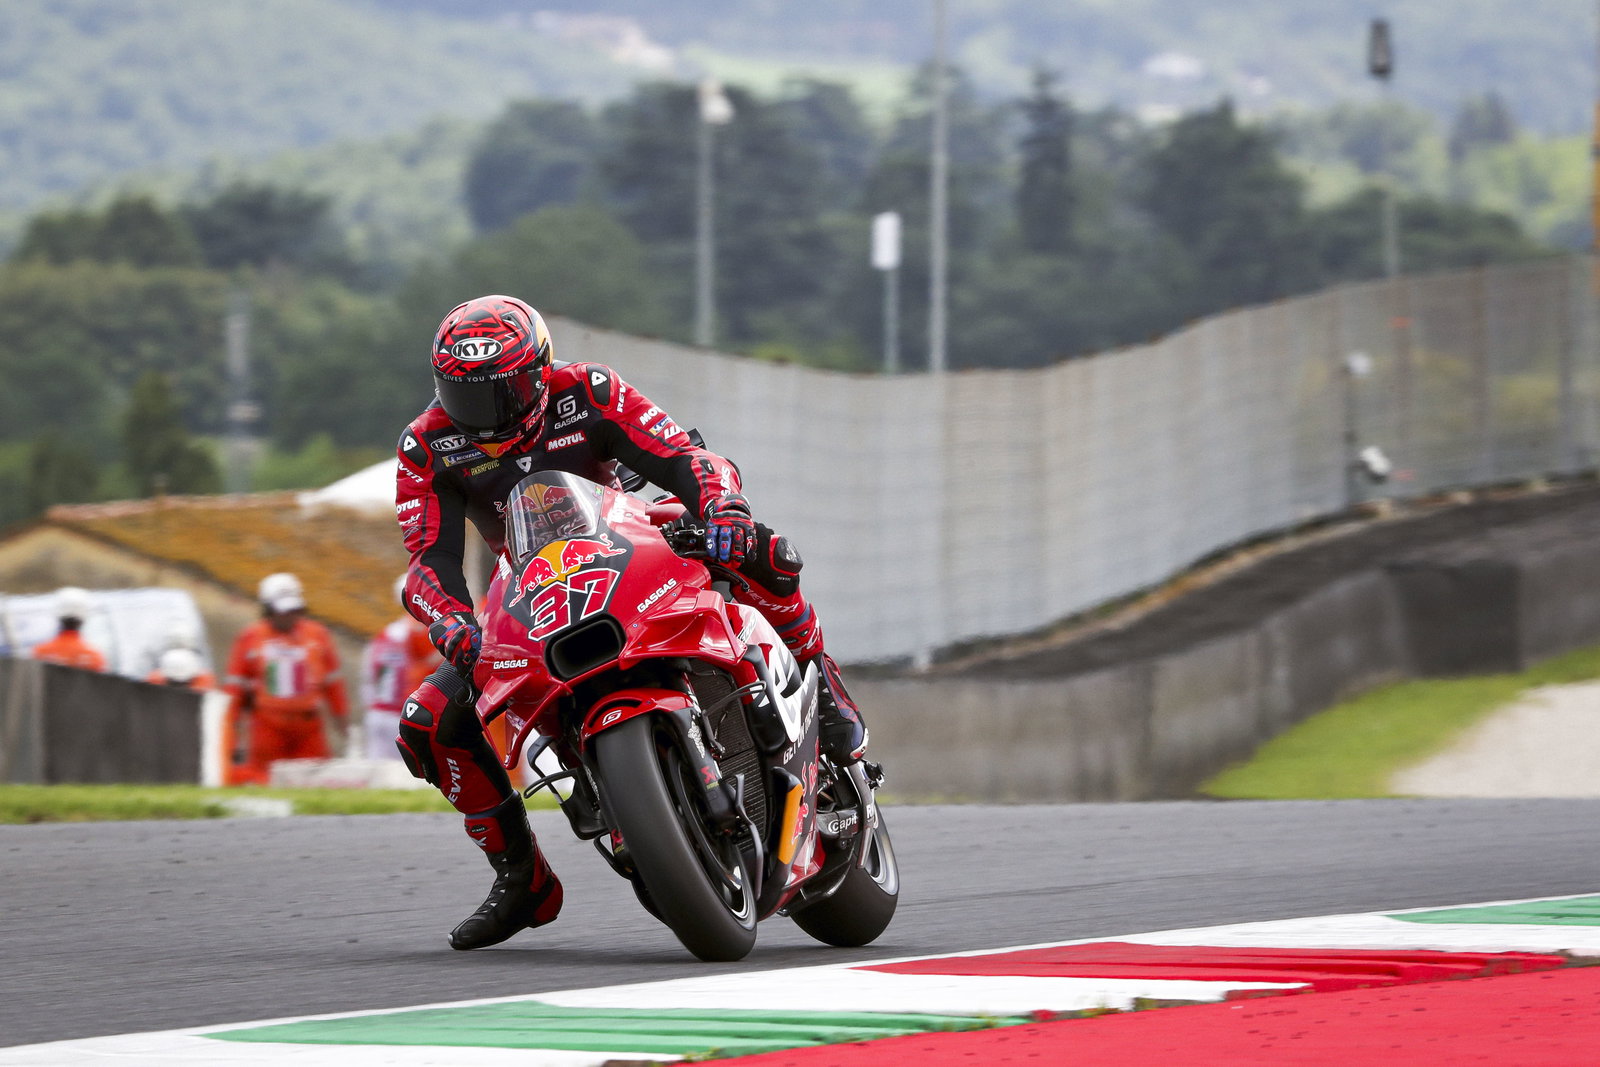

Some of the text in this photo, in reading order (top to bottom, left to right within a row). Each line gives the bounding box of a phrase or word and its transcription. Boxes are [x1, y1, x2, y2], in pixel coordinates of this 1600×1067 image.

[454, 340, 499, 358] KYT
[443, 369, 519, 383] GIVES YOU WINGS
[554, 410, 589, 430] GASGAS
[639, 405, 668, 426] MOT
[433, 435, 467, 450] KYT
[548, 433, 585, 451] MOTUL
[396, 498, 421, 515] OTUL
[637, 578, 677, 613] GASGAS
[528, 568, 621, 642] 37
[493, 659, 528, 670] GASGAS
